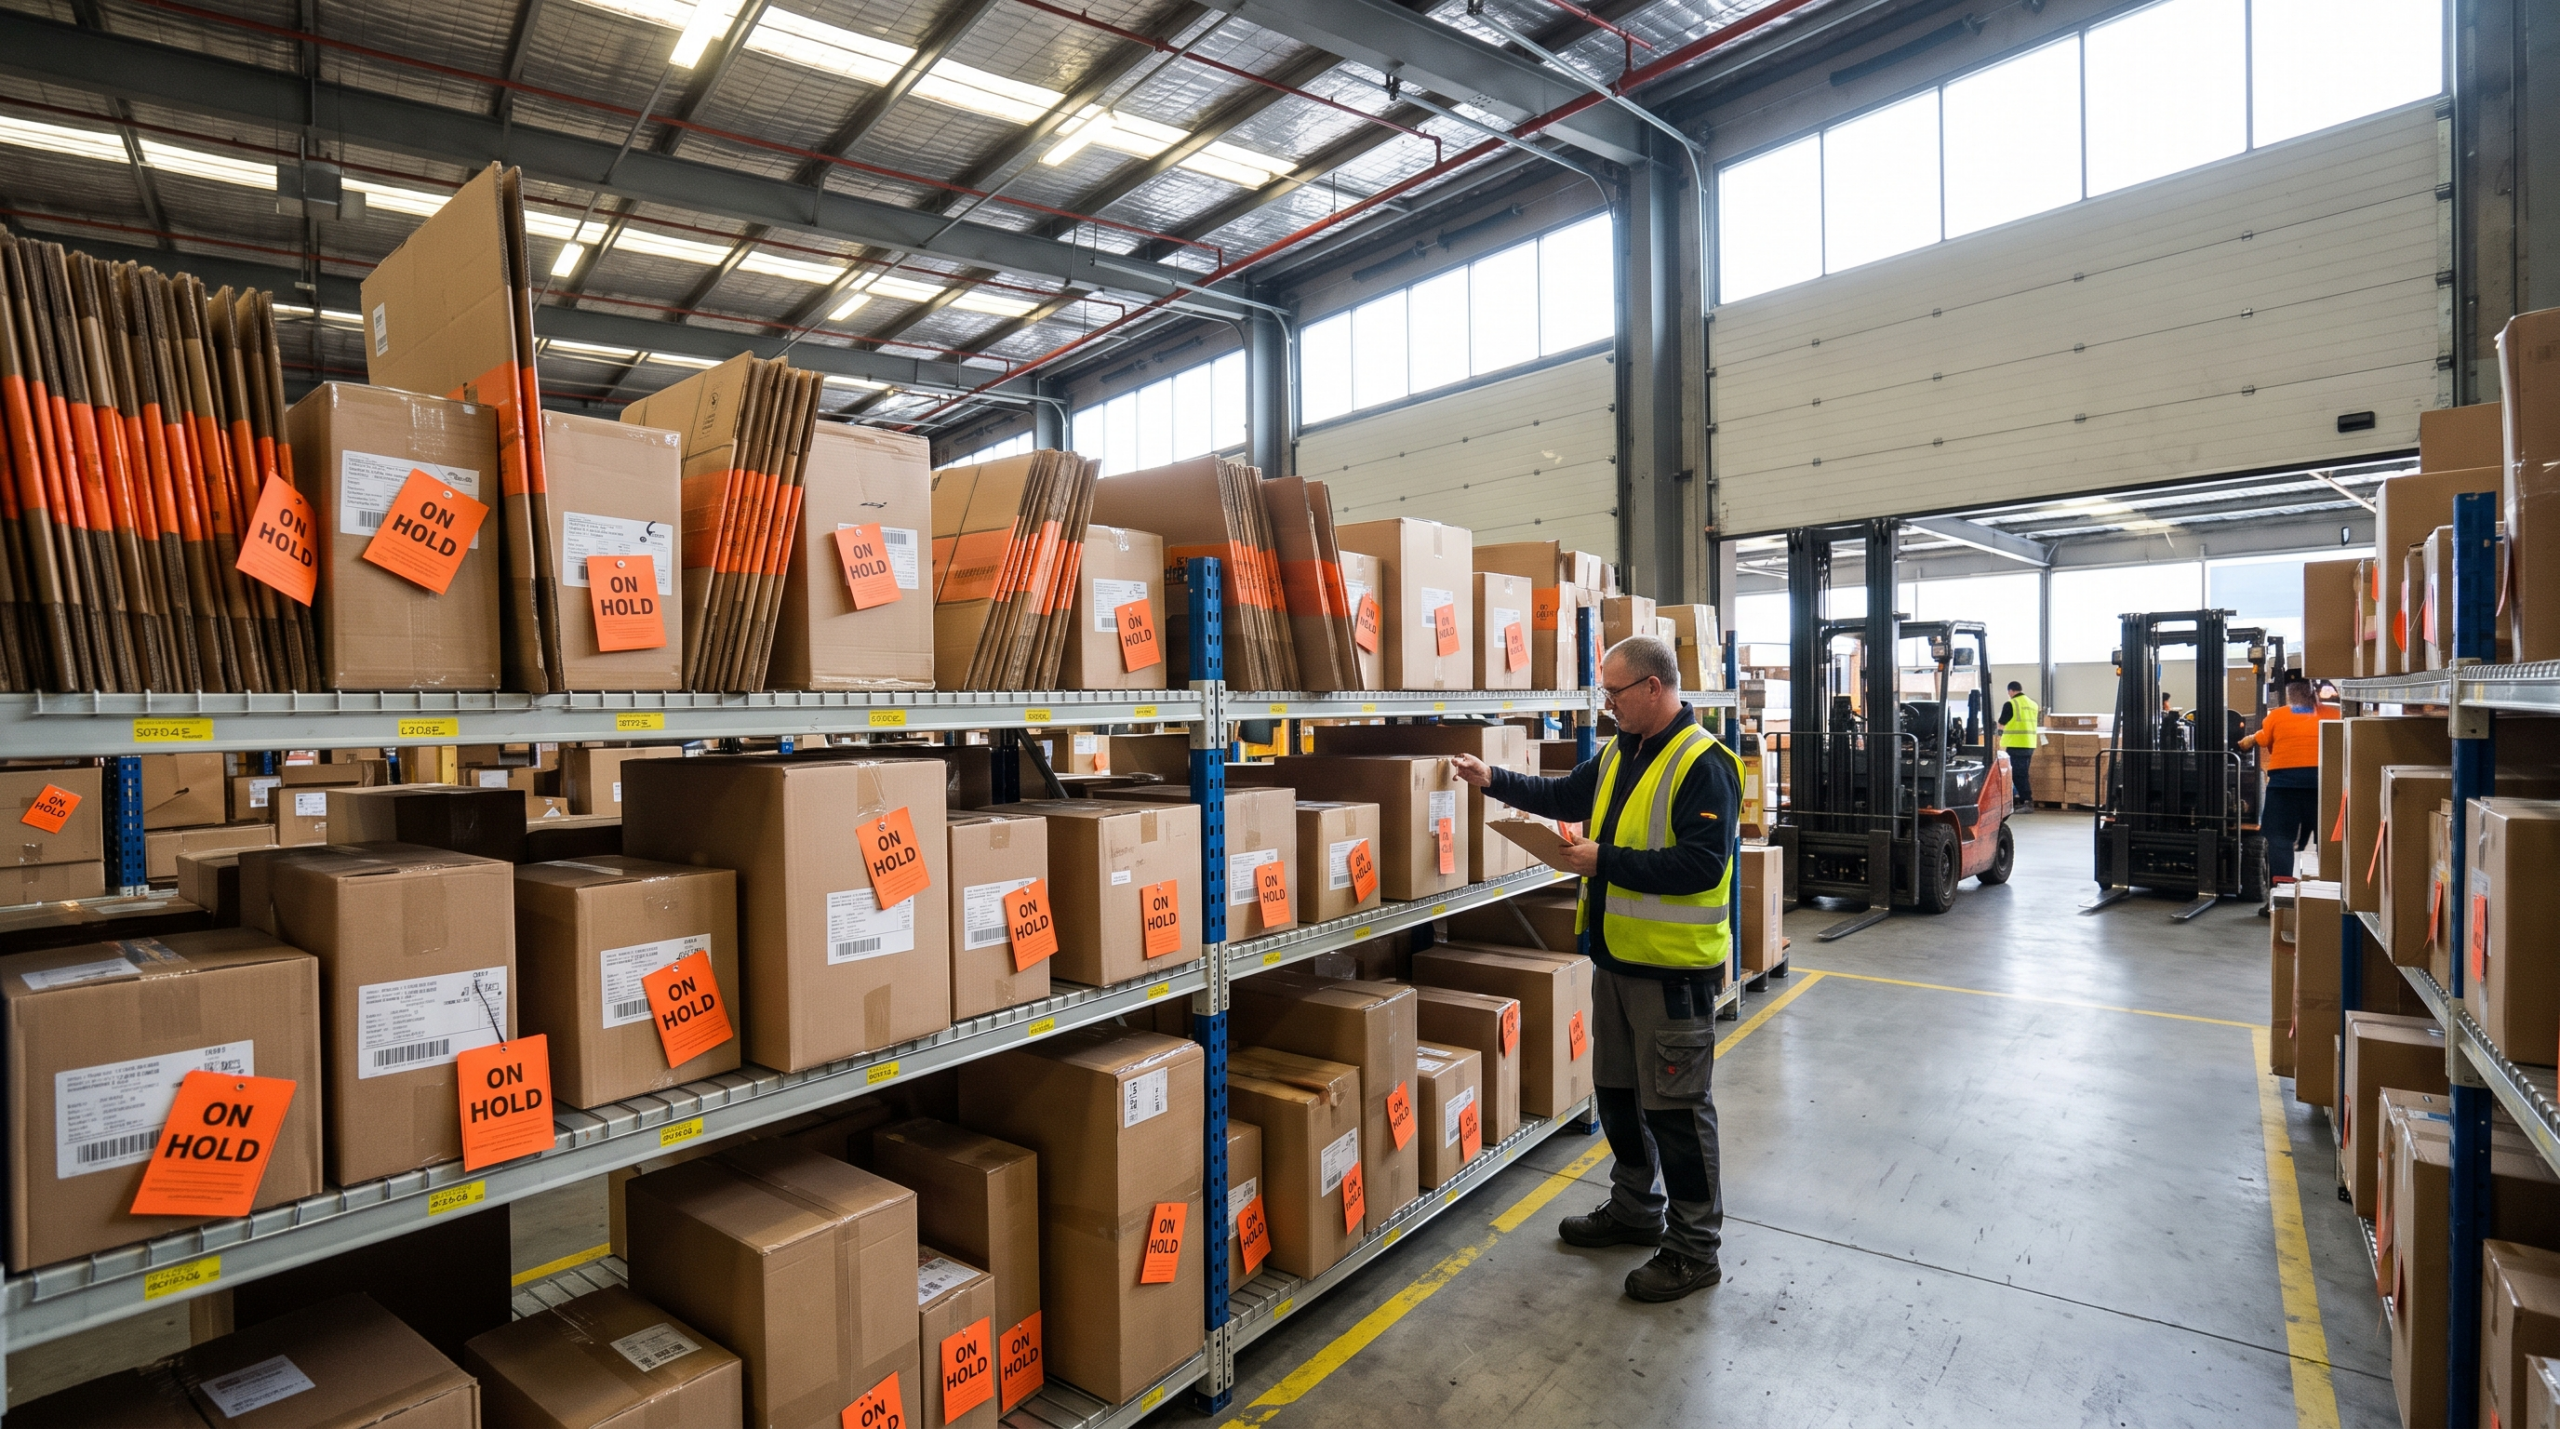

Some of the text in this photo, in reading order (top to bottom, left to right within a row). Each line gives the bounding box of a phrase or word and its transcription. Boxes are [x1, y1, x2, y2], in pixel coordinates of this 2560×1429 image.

[279, 507, 308, 538] ON
[420, 501, 455, 530] ON
[258, 521, 313, 568] HOLD
[392, 514, 457, 557] HOLD
[853, 543, 873, 559] ON
[849, 560, 887, 580] HOLD
[610, 576, 638, 593] ON
[600, 598, 654, 616] HOLD
[1128, 615, 1142, 630] ON
[1124, 629, 1152, 647] HOLD
[34, 801, 66, 818] HOLD
[48, 796, 66, 807] ON
[878, 830, 902, 852] ON
[873, 847, 916, 877] HOLD
[1265, 875, 1278, 888] ON
[1153, 895, 1169, 911] ON
[1262, 888, 1286, 903] HOLD
[1019, 899, 1038, 919] ON
[1015, 914, 1049, 941] HOLD
[1147, 912, 1177, 931] HOLD
[668, 976, 697, 1002] ON
[662, 993, 716, 1031] HOLD
[486, 1062, 524, 1090] ON
[202, 1101, 254, 1128] ON
[470, 1088, 543, 1124] HOLD
[164, 1133, 260, 1163] HOLD
[1159, 1218, 1176, 1234] ON
[1246, 1211, 1258, 1230] ON
[1149, 1238, 1179, 1254] HOLD
[1243, 1222, 1265, 1250] HOLD
[955, 1340, 977, 1364] ON
[1012, 1332, 1030, 1355] ON
[946, 1356, 988, 1392] HOLD
[1004, 1347, 1040, 1381] HOLD
[861, 1399, 886, 1428] ON
